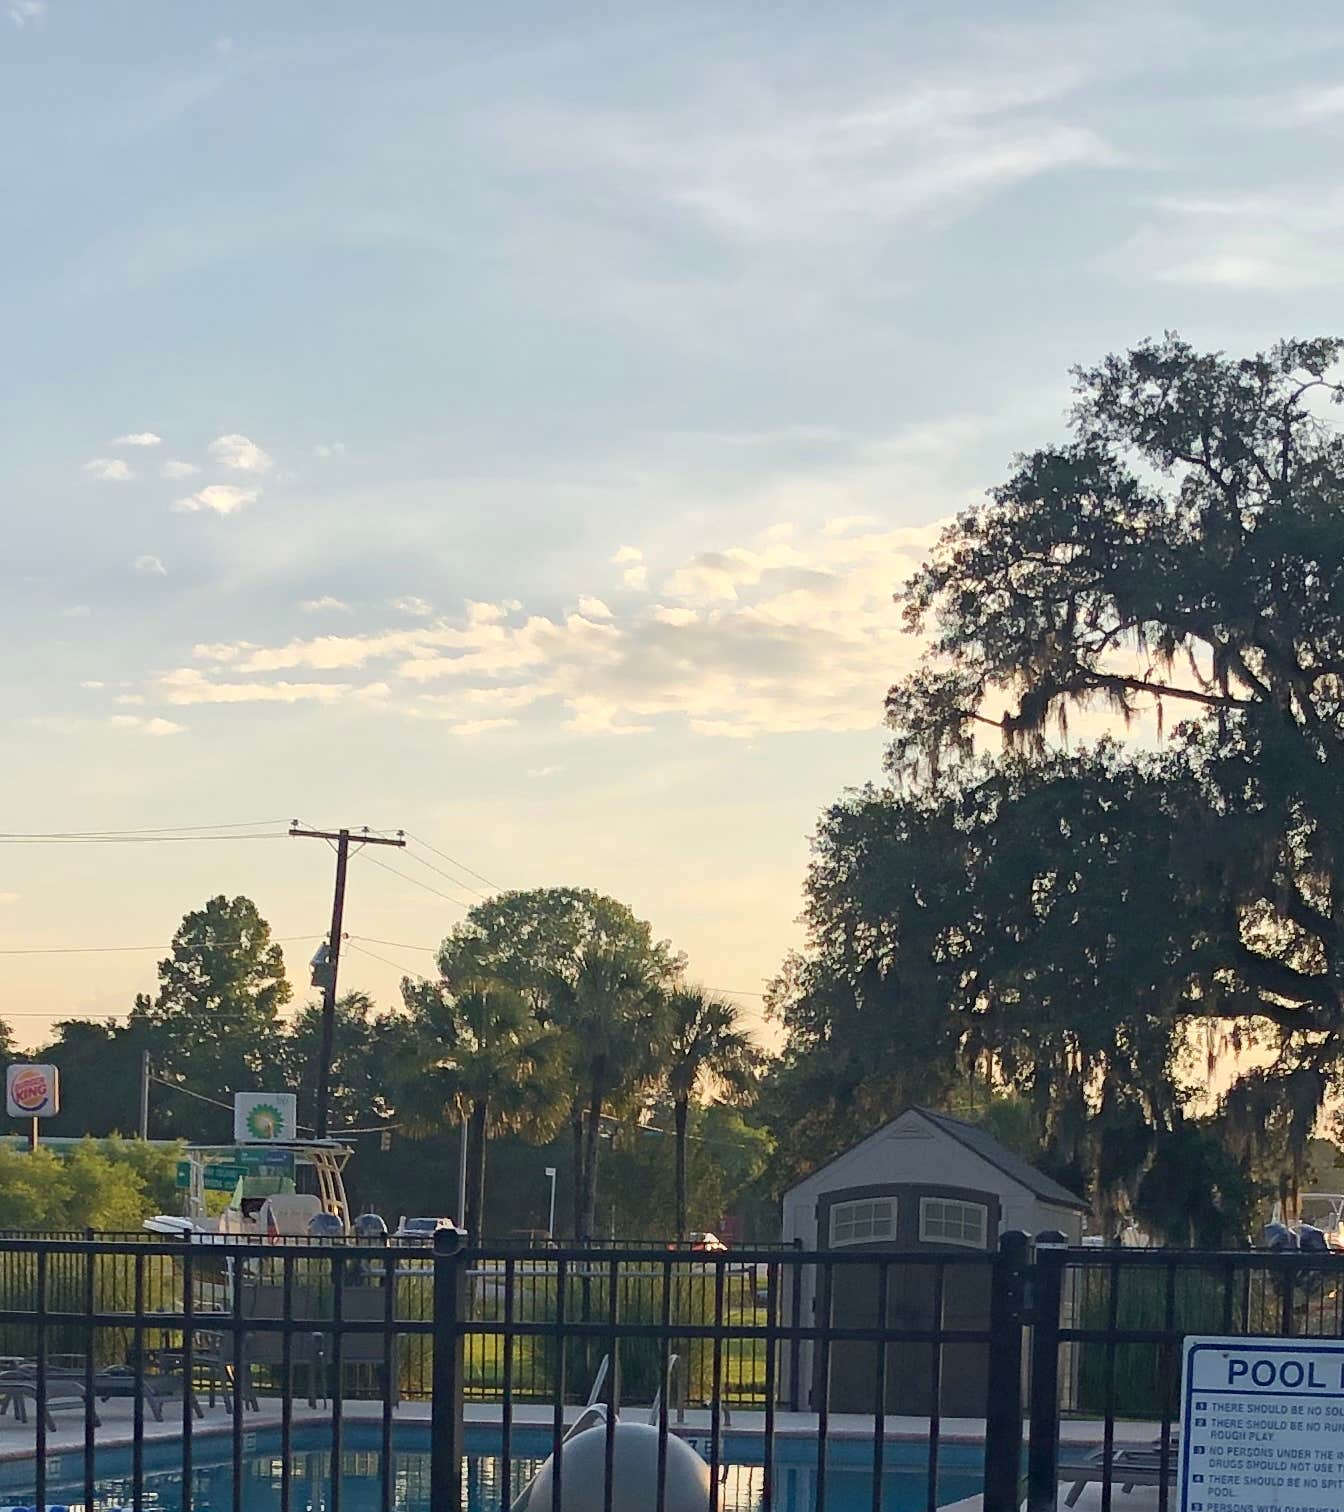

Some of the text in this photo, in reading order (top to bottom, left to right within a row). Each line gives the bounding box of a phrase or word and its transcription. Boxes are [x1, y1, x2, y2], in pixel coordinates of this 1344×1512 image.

[15, 1084, 47, 1102] KING
[1227, 1358, 1327, 1388] POOL
[1211, 1402, 1244, 1413] THERE
[1247, 1403, 1287, 1414] SHOULD
[1290, 1404, 1304, 1415] BE
[1307, 1405, 1321, 1416] NO
[1210, 1418, 1243, 1429] THERE
[1246, 1419, 1286, 1431] SHOULD
[1289, 1420, 1303, 1431] BE
[1305, 1421, 1320, 1432] NO
[1226, 1446, 1273, 1458] PERSONS
[1276, 1448, 1311, 1459] UNDER
[1314, 1450, 1333, 1460] THE
[1208, 1459, 1244, 1469] DRUGS
[1245, 1460, 1287, 1471] SHOULD
[1289, 1462, 1310, 1472] NOT
[1313, 1463, 1333, 1473] USE
[1208, 1474, 1241, 1485] THERE
[1243, 1476, 1284, 1487] SHOULD
[1286, 1477, 1300, 1487] BE
[1303, 1478, 1317, 1488] NO
